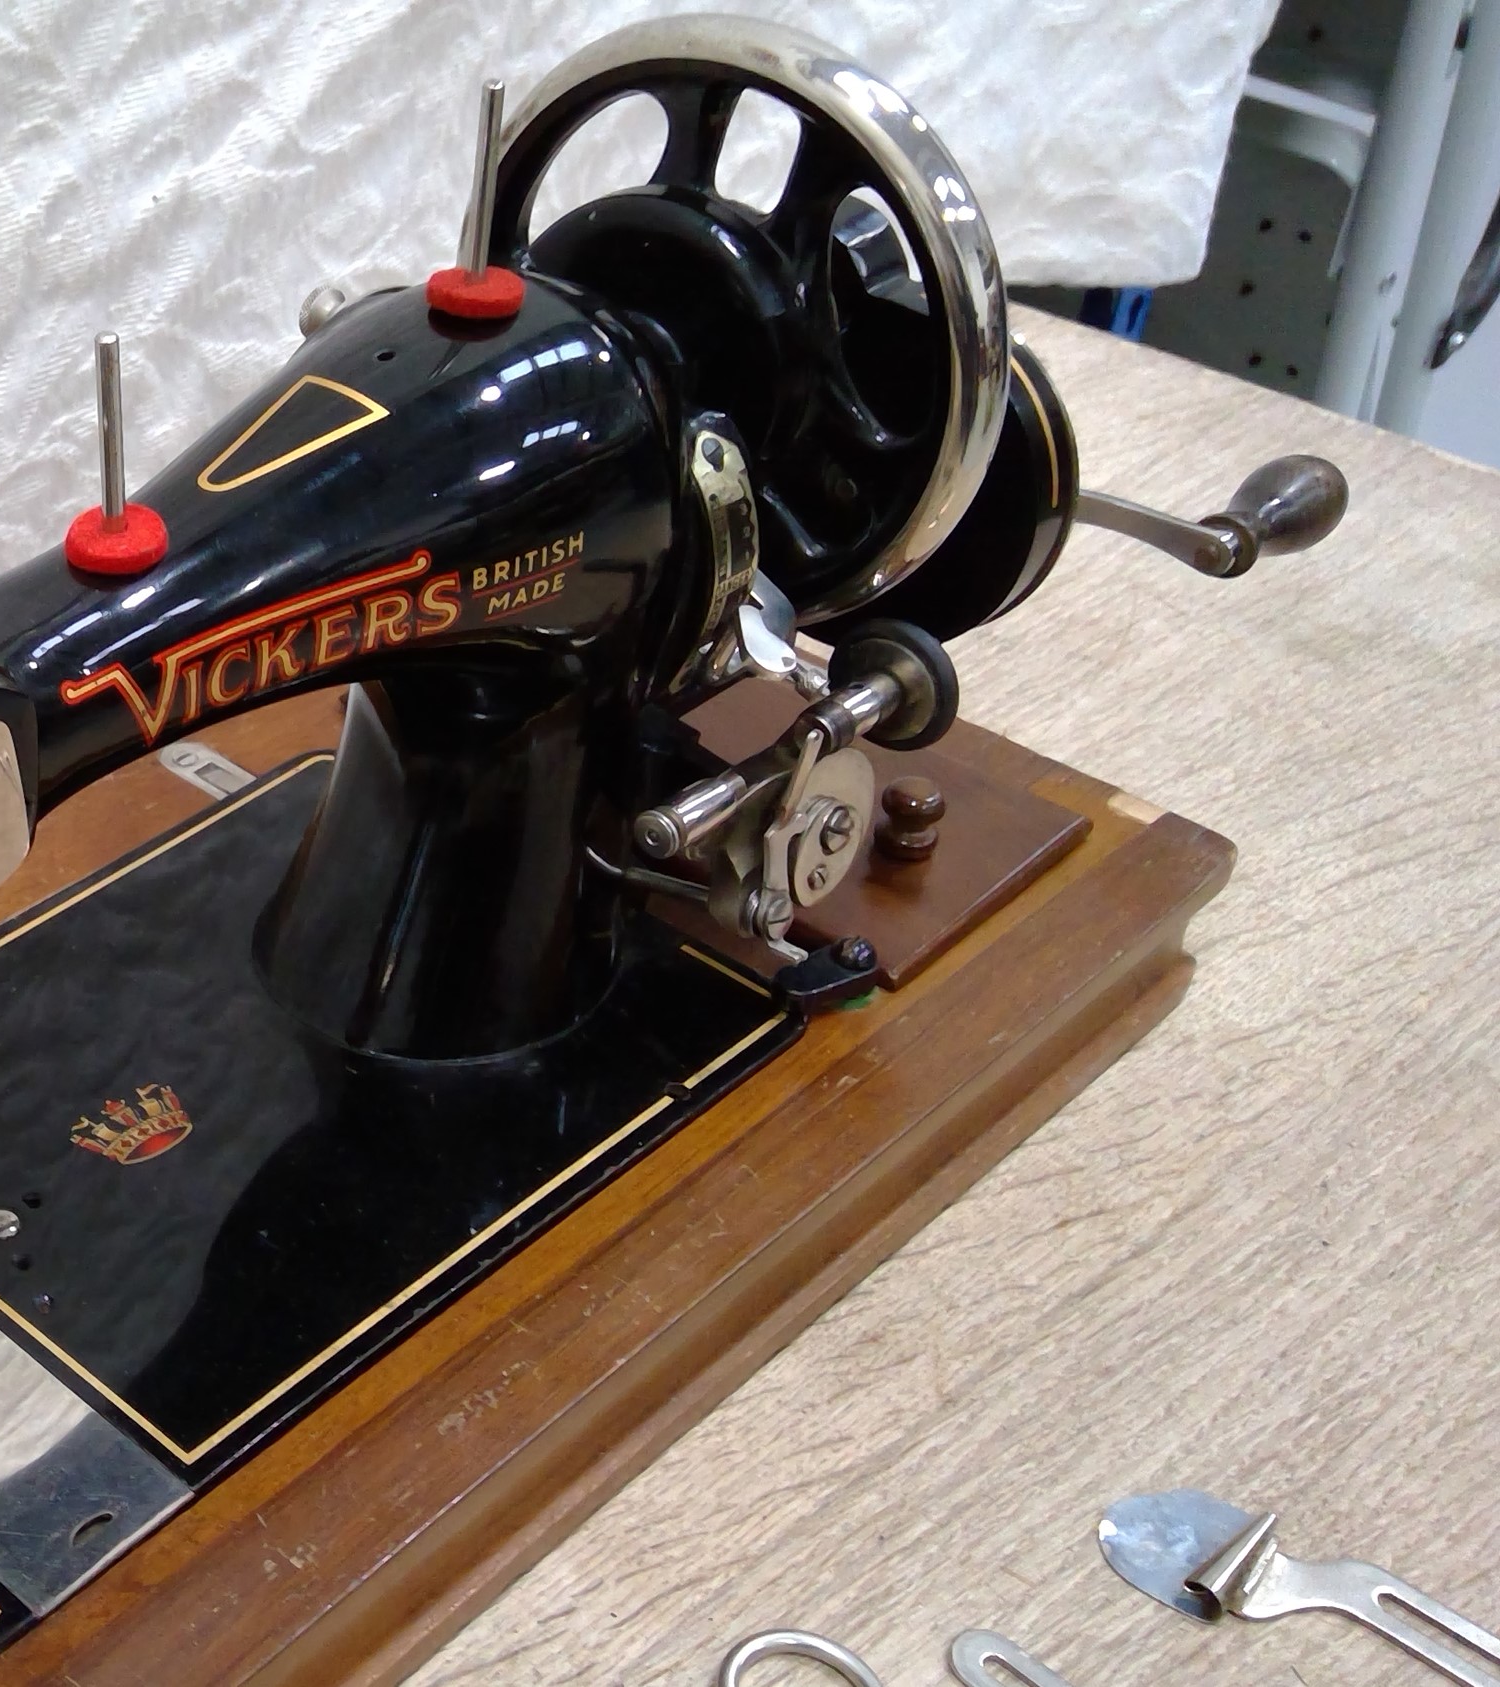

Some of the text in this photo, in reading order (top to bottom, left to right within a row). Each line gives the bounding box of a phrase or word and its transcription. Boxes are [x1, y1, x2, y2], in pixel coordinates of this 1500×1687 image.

[472, 530, 585, 591] BRITISH
[487, 572, 566, 615] MADE
[60, 549, 462, 748] VICKERS
